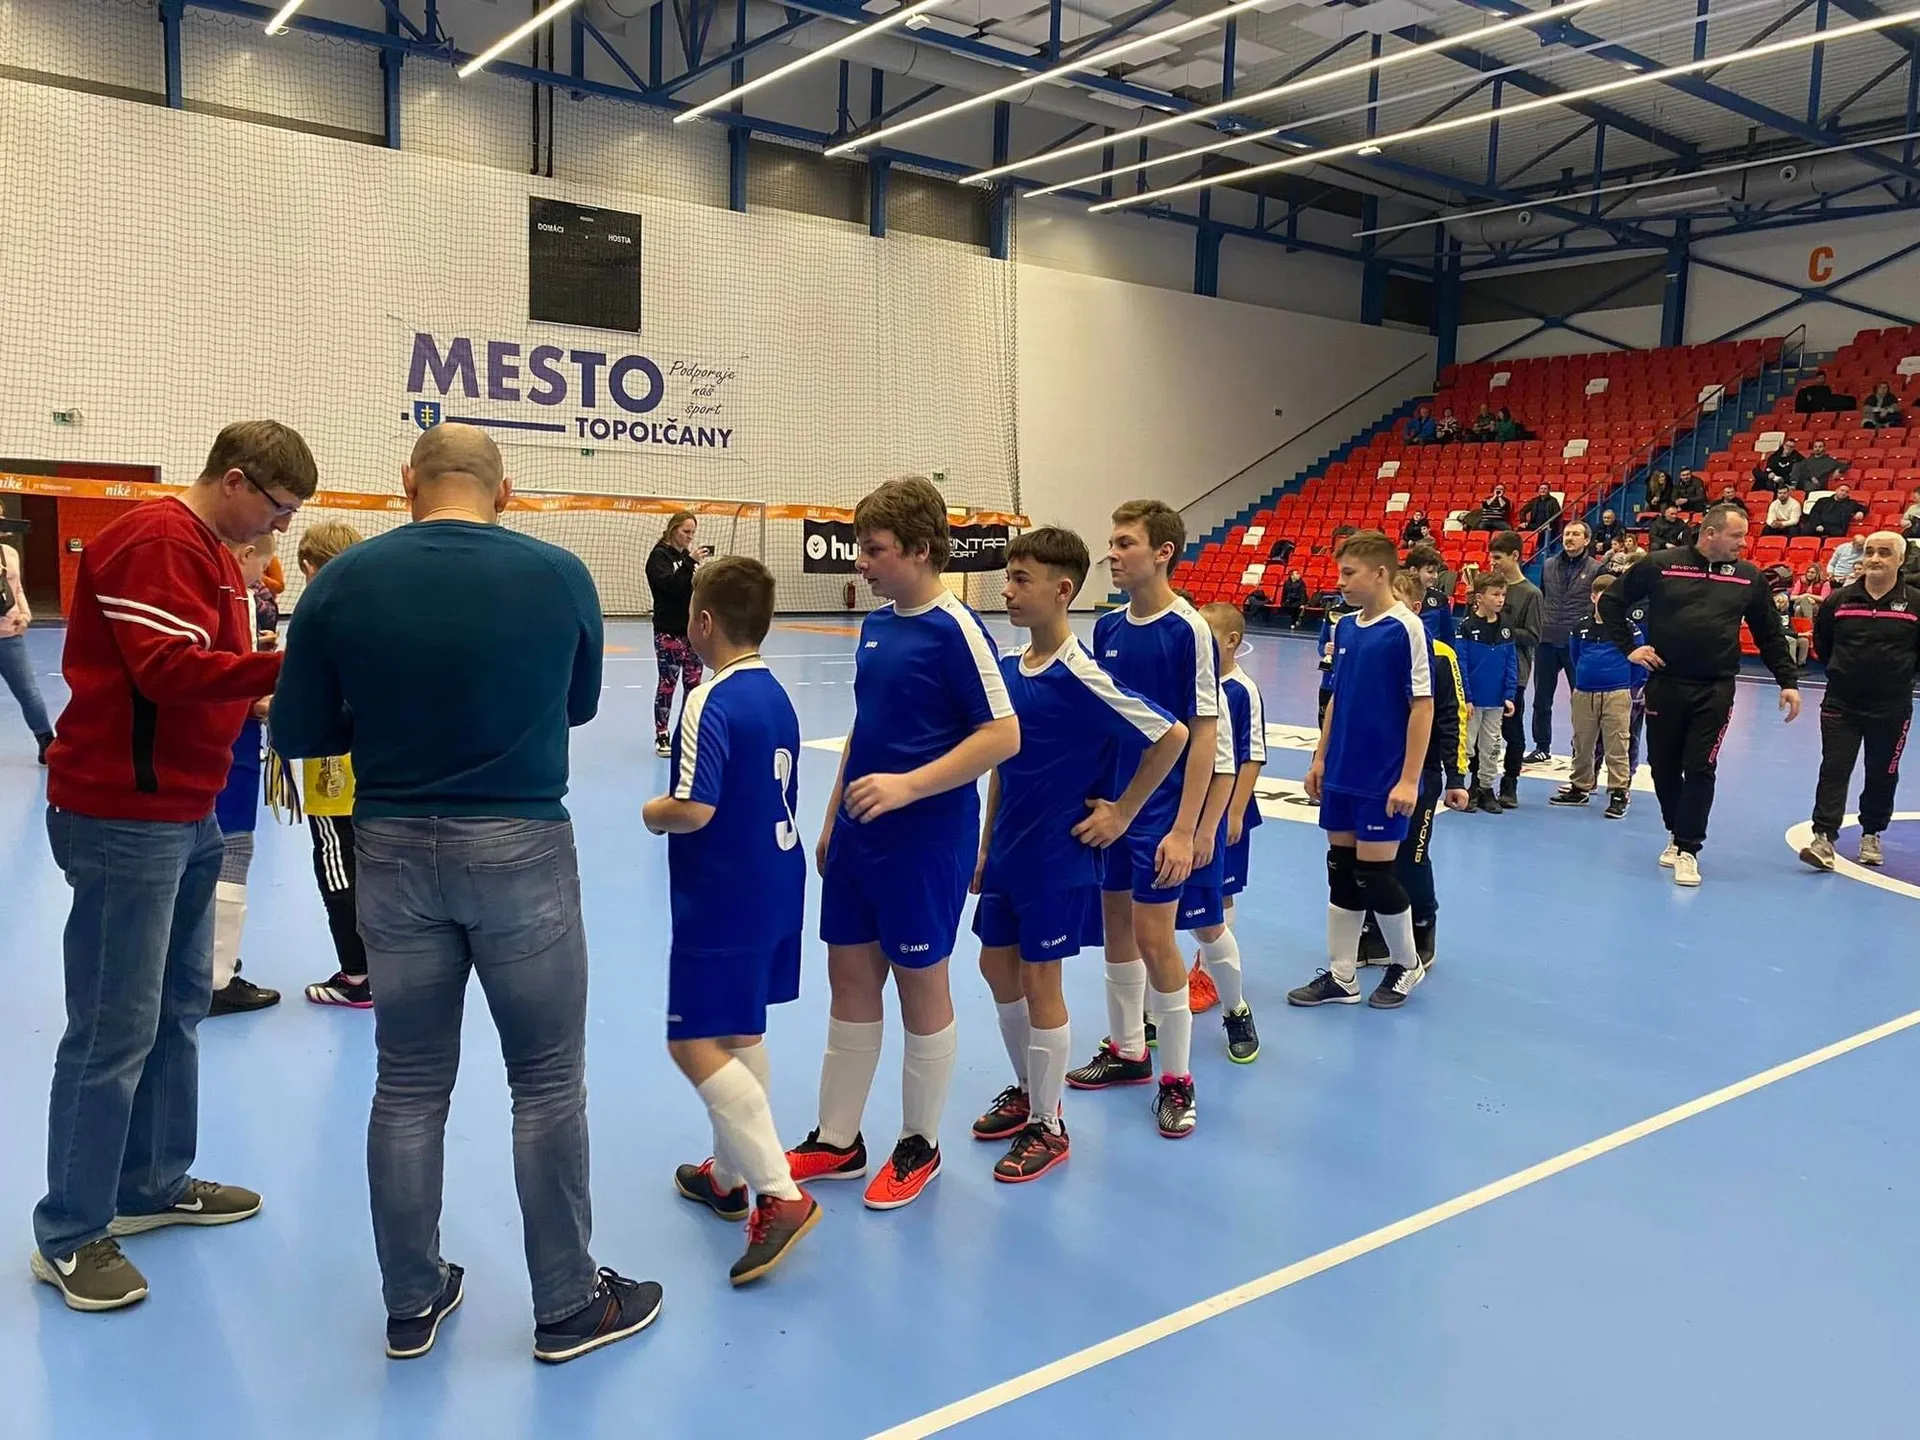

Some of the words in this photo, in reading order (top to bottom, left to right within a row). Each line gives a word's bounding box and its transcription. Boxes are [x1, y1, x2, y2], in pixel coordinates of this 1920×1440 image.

[608, 233, 632, 245] HOSTIA
[1808, 246, 1834, 283] C
[406, 332, 665, 414] MESTO
[668, 360, 736, 385] Podporuje
[691, 384, 716, 397] náš
[684, 402, 724, 419] šport
[575, 417, 733, 449] TOPOĽČANY
[104, 483, 131, 498] niké
[774, 748, 798, 851] 3
[1414, 808, 1432, 863] GIVOVA
[909, 943, 930, 952] JAKO
[1050, 934, 1067, 947] JAKO
